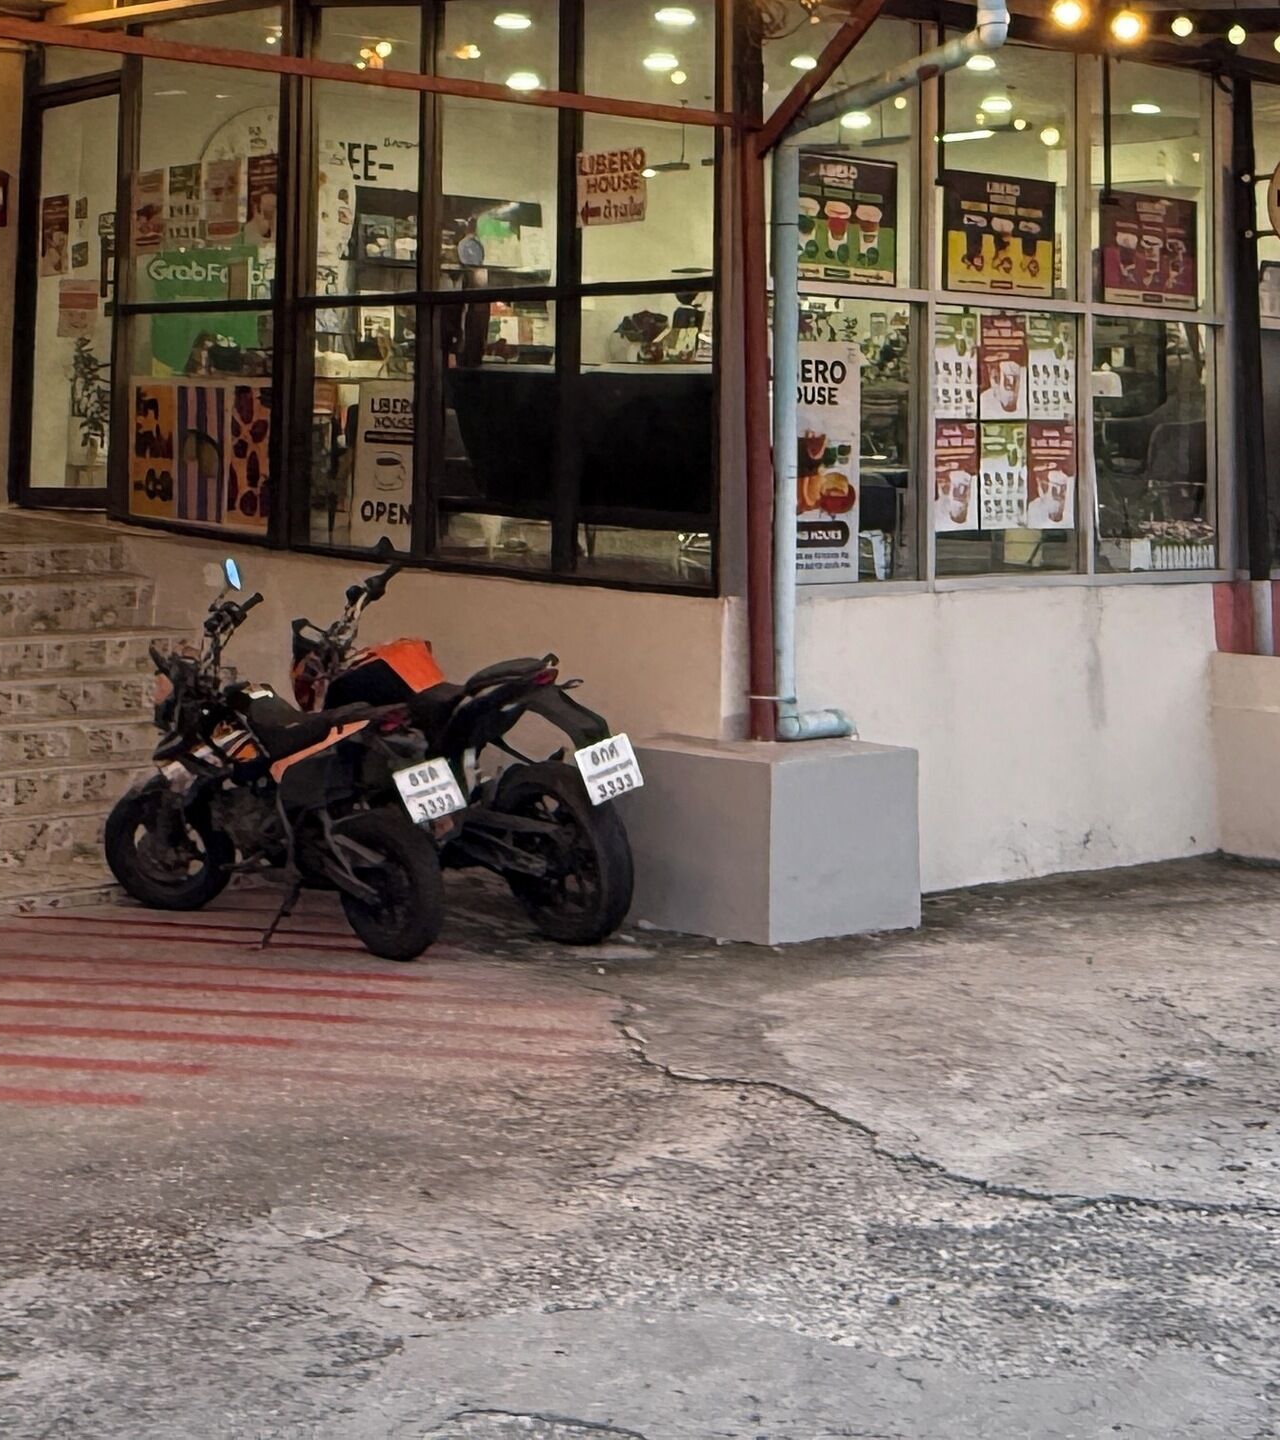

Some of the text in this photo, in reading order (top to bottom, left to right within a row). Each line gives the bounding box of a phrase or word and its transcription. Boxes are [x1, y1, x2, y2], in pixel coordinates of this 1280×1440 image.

[579, 147, 645, 176] LIBERO
[587, 172, 639, 194] HOUSE
[360, 500, 414, 526] OPEN
